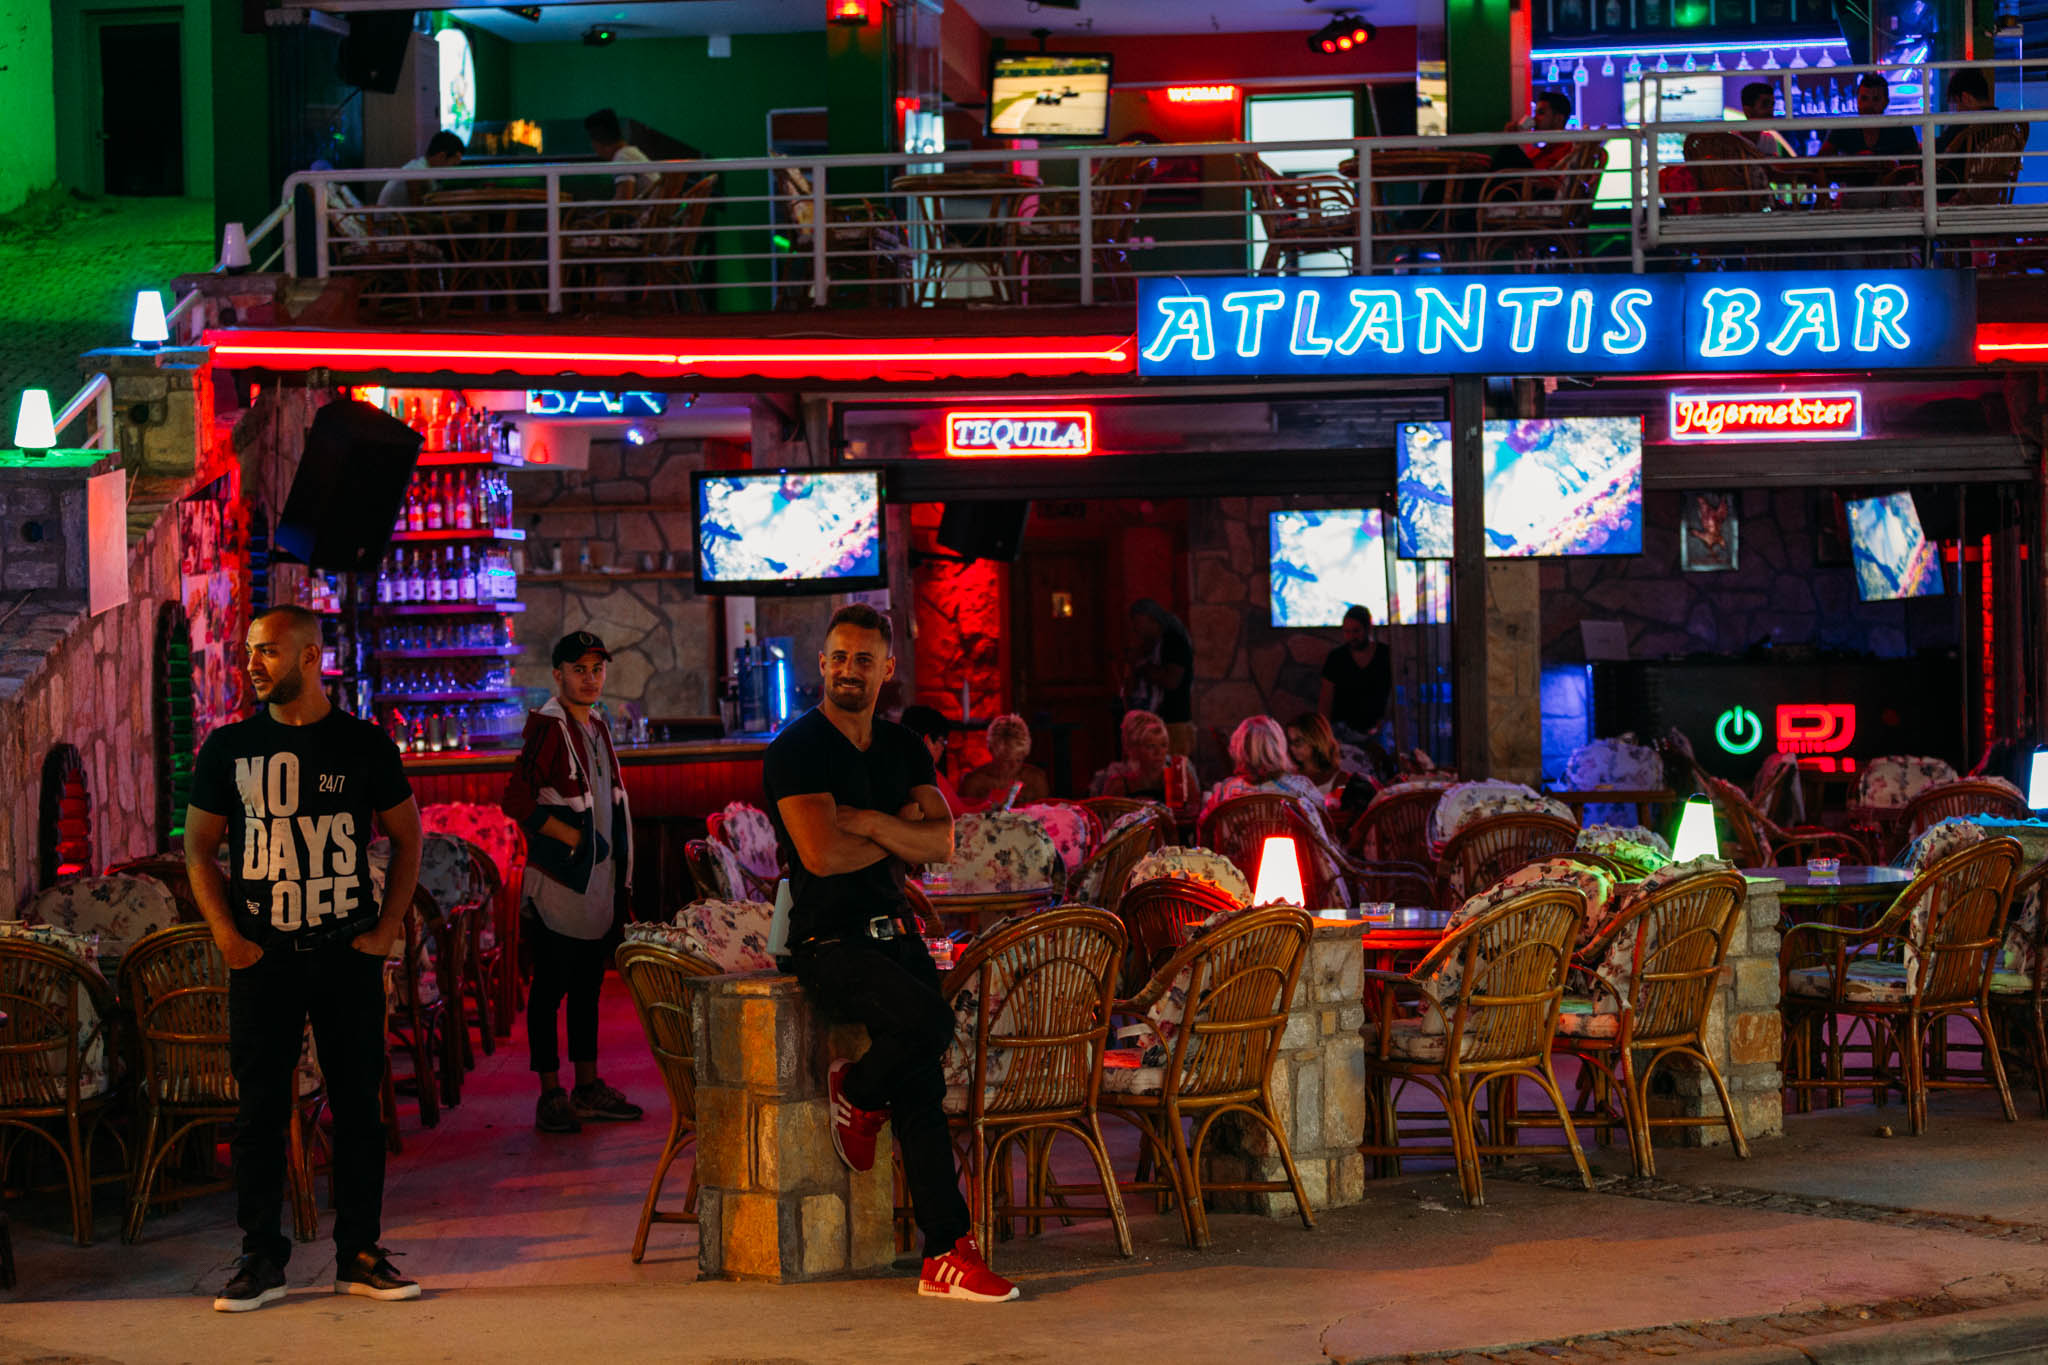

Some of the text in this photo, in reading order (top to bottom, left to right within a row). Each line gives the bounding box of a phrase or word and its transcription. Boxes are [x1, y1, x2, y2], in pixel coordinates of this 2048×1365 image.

[1141, 283, 1911, 362] ATLANTIS BAR
[953, 419, 1086, 451] TEQUILA
[234, 751, 300, 818] NO
[319, 774, 346, 793] 24/7
[242, 811, 358, 881] DAYS
[270, 874, 361, 932] OFF
